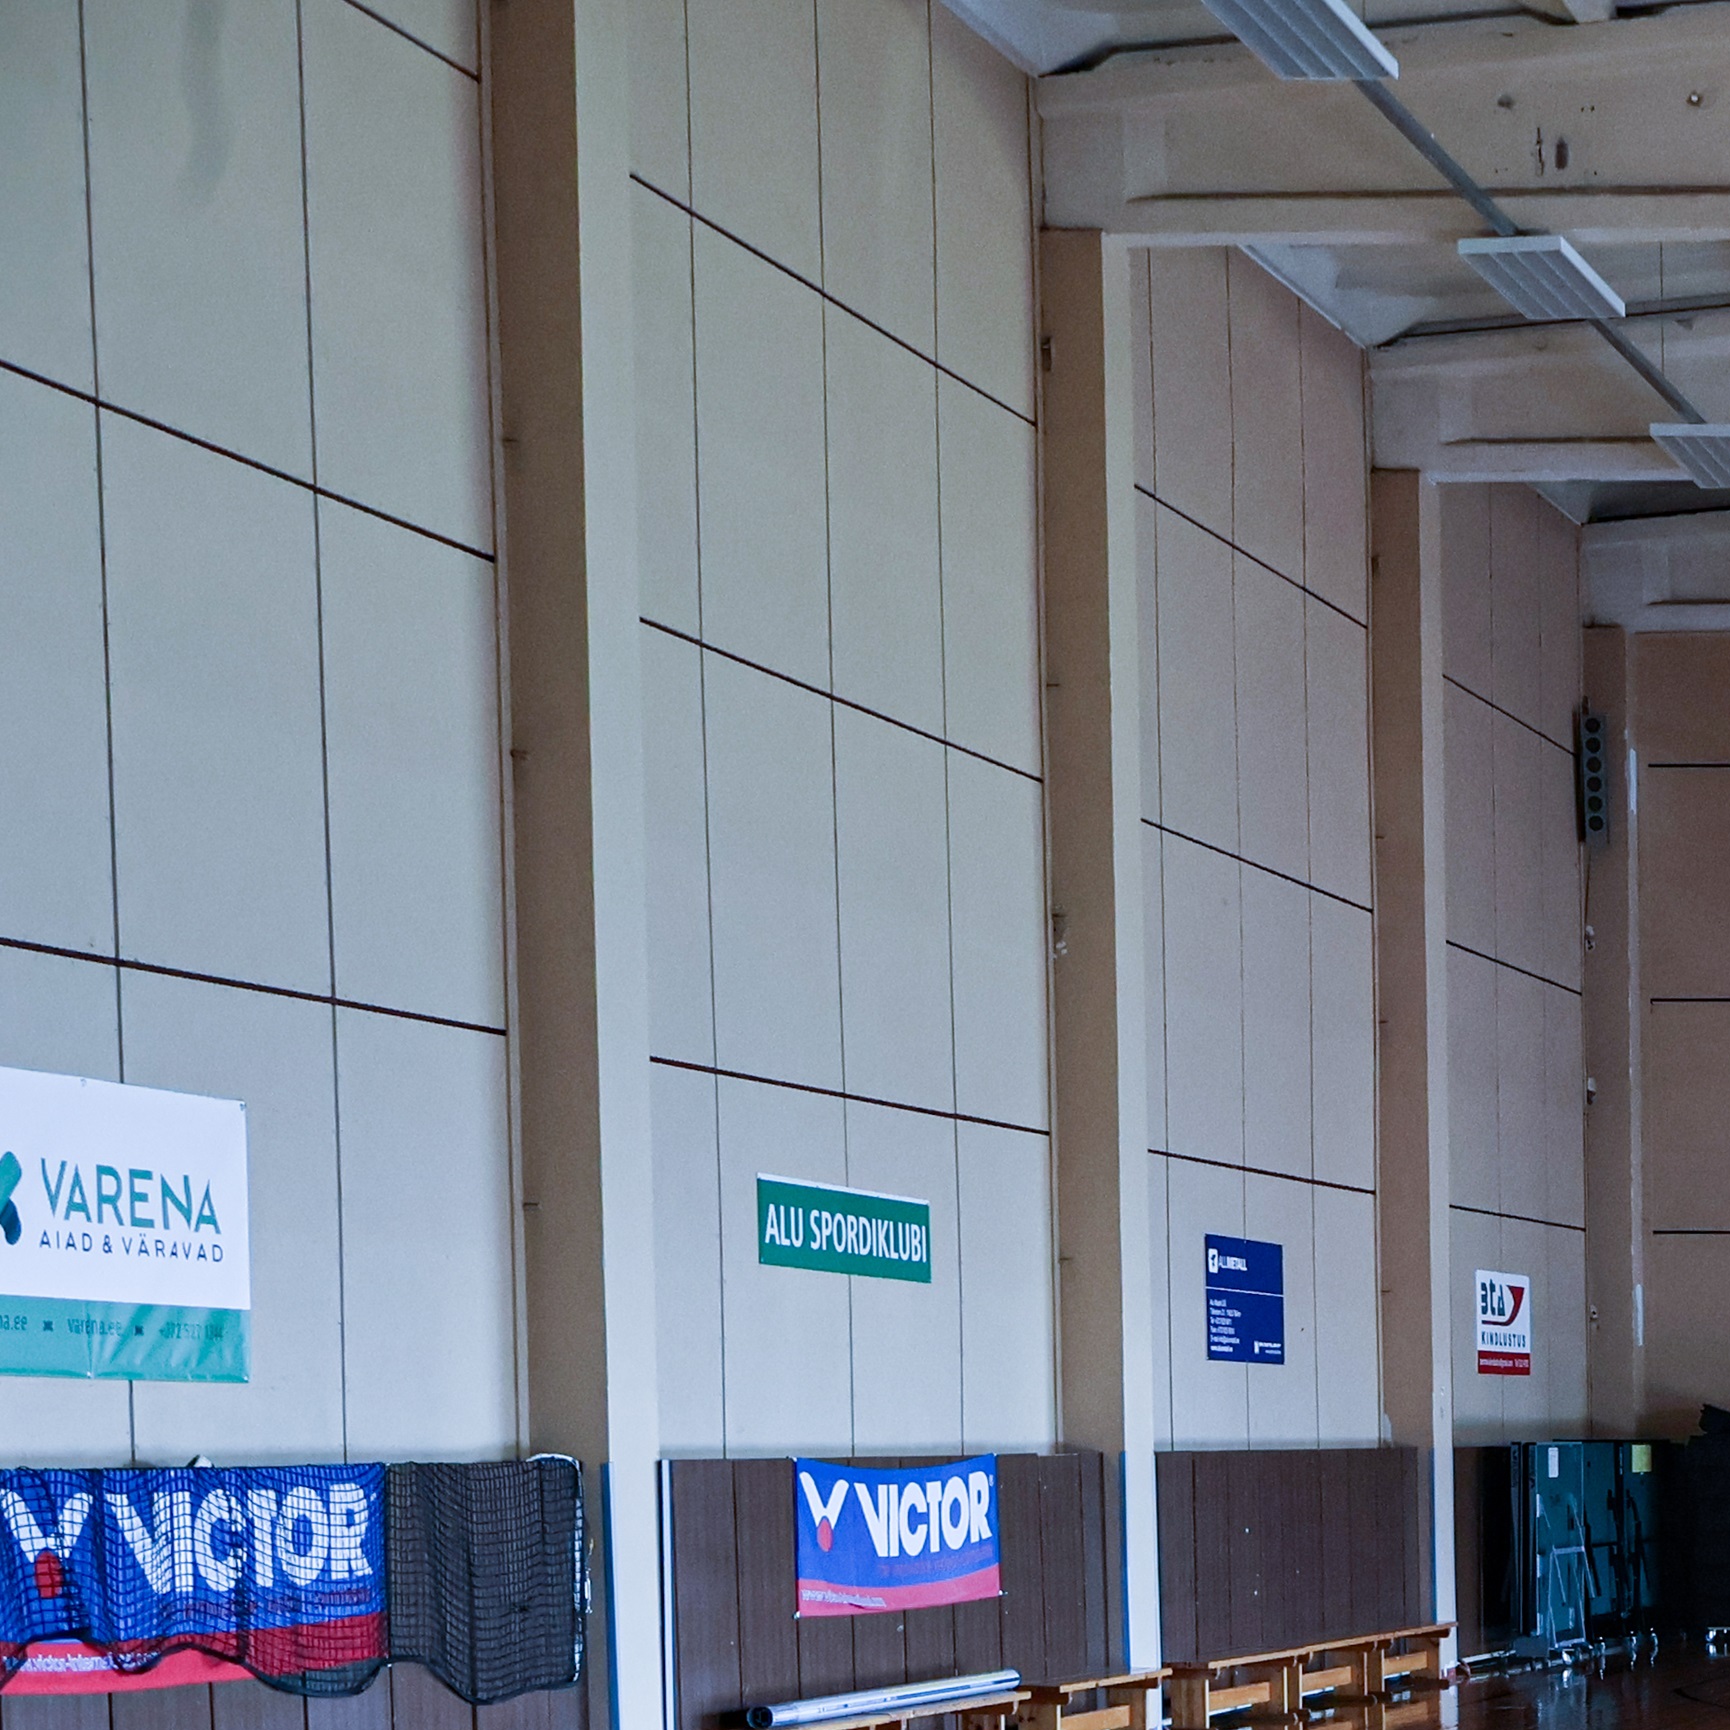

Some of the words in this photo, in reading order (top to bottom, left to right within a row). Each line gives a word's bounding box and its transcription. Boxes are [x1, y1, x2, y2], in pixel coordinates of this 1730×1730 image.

[41, 1158, 221, 1235] VARENA
[39, 1229, 93, 1252] AIAD
[102, 1234, 113, 1254] &
[121, 1233, 224, 1263] VÄRAVAD
[764, 1203, 804, 1248] ALU
[810, 1209, 927, 1263] SPORDIKLUBI
[1481, 1331, 1526, 1348] KINDLUSTUS
[105, 1483, 374, 1594] VICTOR
[853, 1471, 993, 1558] VICTOR
